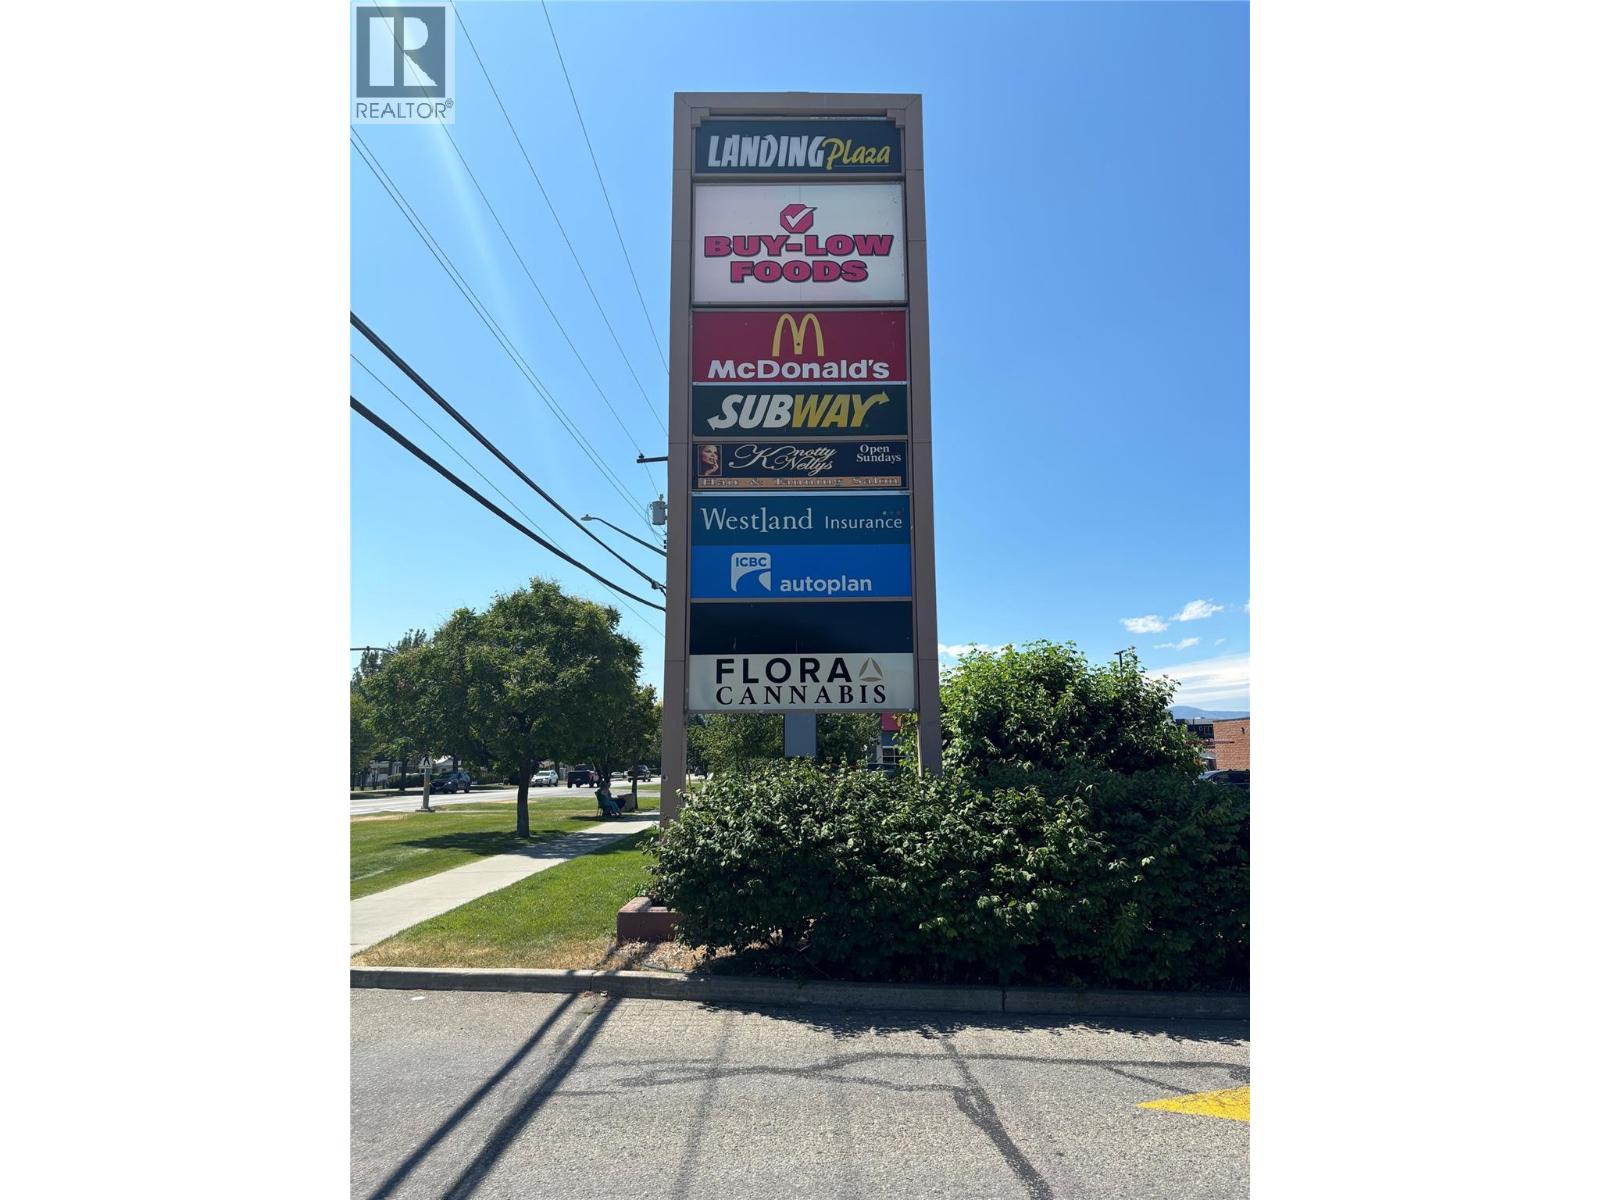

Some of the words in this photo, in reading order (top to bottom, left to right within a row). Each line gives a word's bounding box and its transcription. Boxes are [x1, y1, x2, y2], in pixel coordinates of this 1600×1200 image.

[707, 135, 826, 168] LANDING
[822, 137, 891, 170] Plaza
[703, 234, 894, 258] BUY-LOW
[730, 259, 869, 284] FOODS
[707, 359, 891, 380] McDonald's
[707, 391, 890, 431] SUBWAY
[728, 444, 838, 471] Knotty
[856, 452, 902, 464] Sundays
[859, 443, 891, 455] Open
[700, 507, 813, 533] Westland
[824, 515, 903, 530] Insurance
[735, 556, 768, 568] ICBC
[779, 575, 873, 595] autoplan
[715, 656, 853, 685] FLORA
[715, 684, 887, 706] CANNABIS
